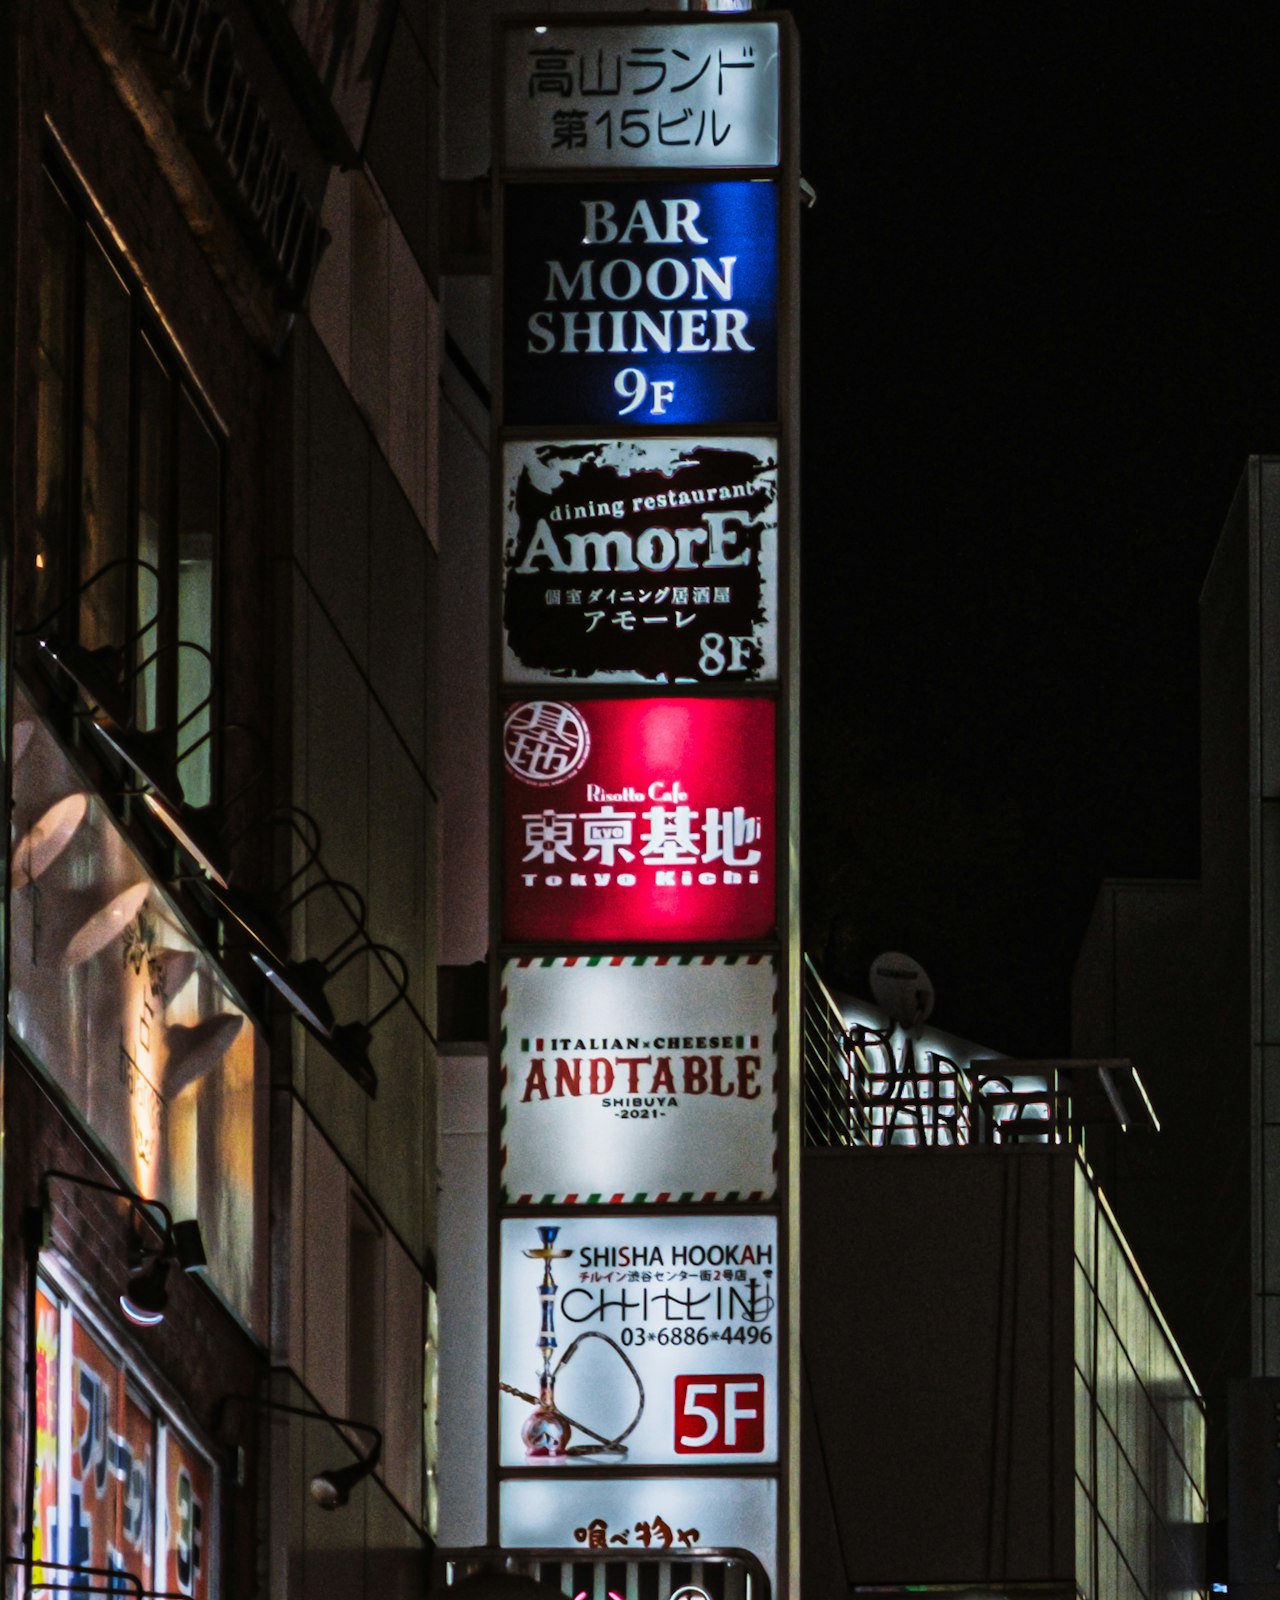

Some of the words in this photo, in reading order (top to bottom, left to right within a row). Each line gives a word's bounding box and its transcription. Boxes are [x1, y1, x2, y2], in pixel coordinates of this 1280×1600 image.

[529, 47, 755, 97] 高山ランド
[552, 109, 731, 149] 第15ビル
[581, 199, 708, 245] BAR
[545, 256, 737, 302] MOON
[528, 308, 755, 355] SHINER
[613, 367, 675, 417] 9F
[550, 500, 625, 522] dining
[632, 481, 755, 512] restaurant
[515, 510, 751, 573] AmorE
[545, 586, 731, 606] 個室ダイニング居酒屋
[584, 610, 697, 633] アモーレ
[699, 632, 759, 677] 8F
[521, 806, 762, 866] 東京基地
[522, 872, 637, 887] Tokyo
[655, 870, 759, 886] Kichi
[520, 1054, 762, 1103] ANDTABLE
[602, 1097, 679, 1108] SHIBUYA
[579, 1246, 664, 1268] SHISHA
[672, 1245, 772, 1267] HOOKAH
[579, 1270, 747, 1283] チルイン渋谷センター街2号店
[678, 1383, 759, 1448] 5F
